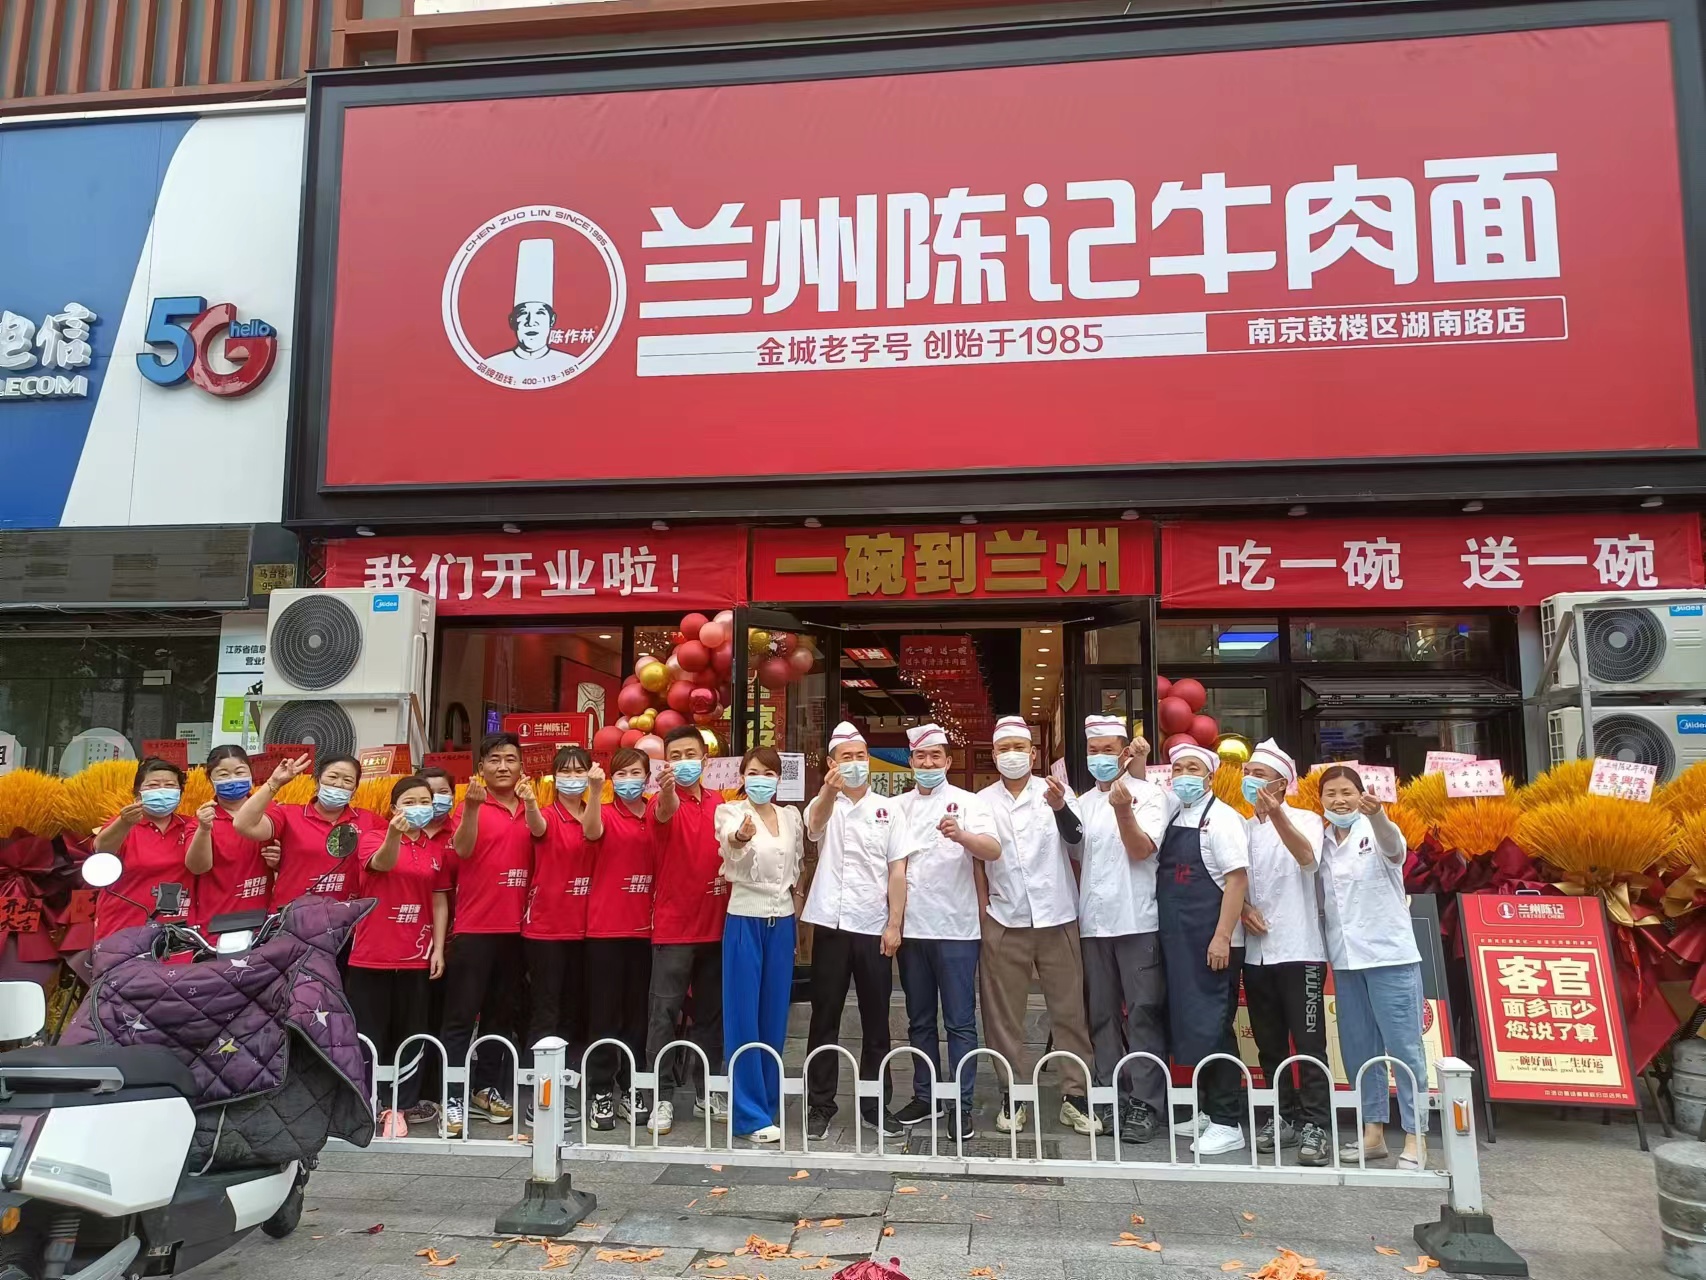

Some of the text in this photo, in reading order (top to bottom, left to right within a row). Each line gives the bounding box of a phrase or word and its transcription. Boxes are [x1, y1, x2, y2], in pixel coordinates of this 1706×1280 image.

[465, 223, 496, 252] CHEN
[498, 211, 526, 226] ZUO
[530, 209, 551, 217] LIN
[639, 153, 1561, 319] 兰州陈记牛肉面
[229, 319, 277, 338] hello
[548, 328, 595, 344] 陈作林
[755, 322, 1105, 367] 金城老字号 创始于1985
[1247, 306, 1526, 345] 南京鼓楼区湖南路店
[136, 296, 278, 398] 5G
[775, 527, 1121, 596] 一碗到兰州
[1217, 533, 1659, 592] 吃一碗 送一碗
[375, 599, 398, 608] Midea
[534, 722, 570, 733] 兰州陈记
[1517, 903, 1564, 915] 兰州陈记
[1496, 955, 1592, 996] 客官
[1501, 997, 1598, 1020] 面多面少
[1504, 1020, 1599, 1043] 您说了算
